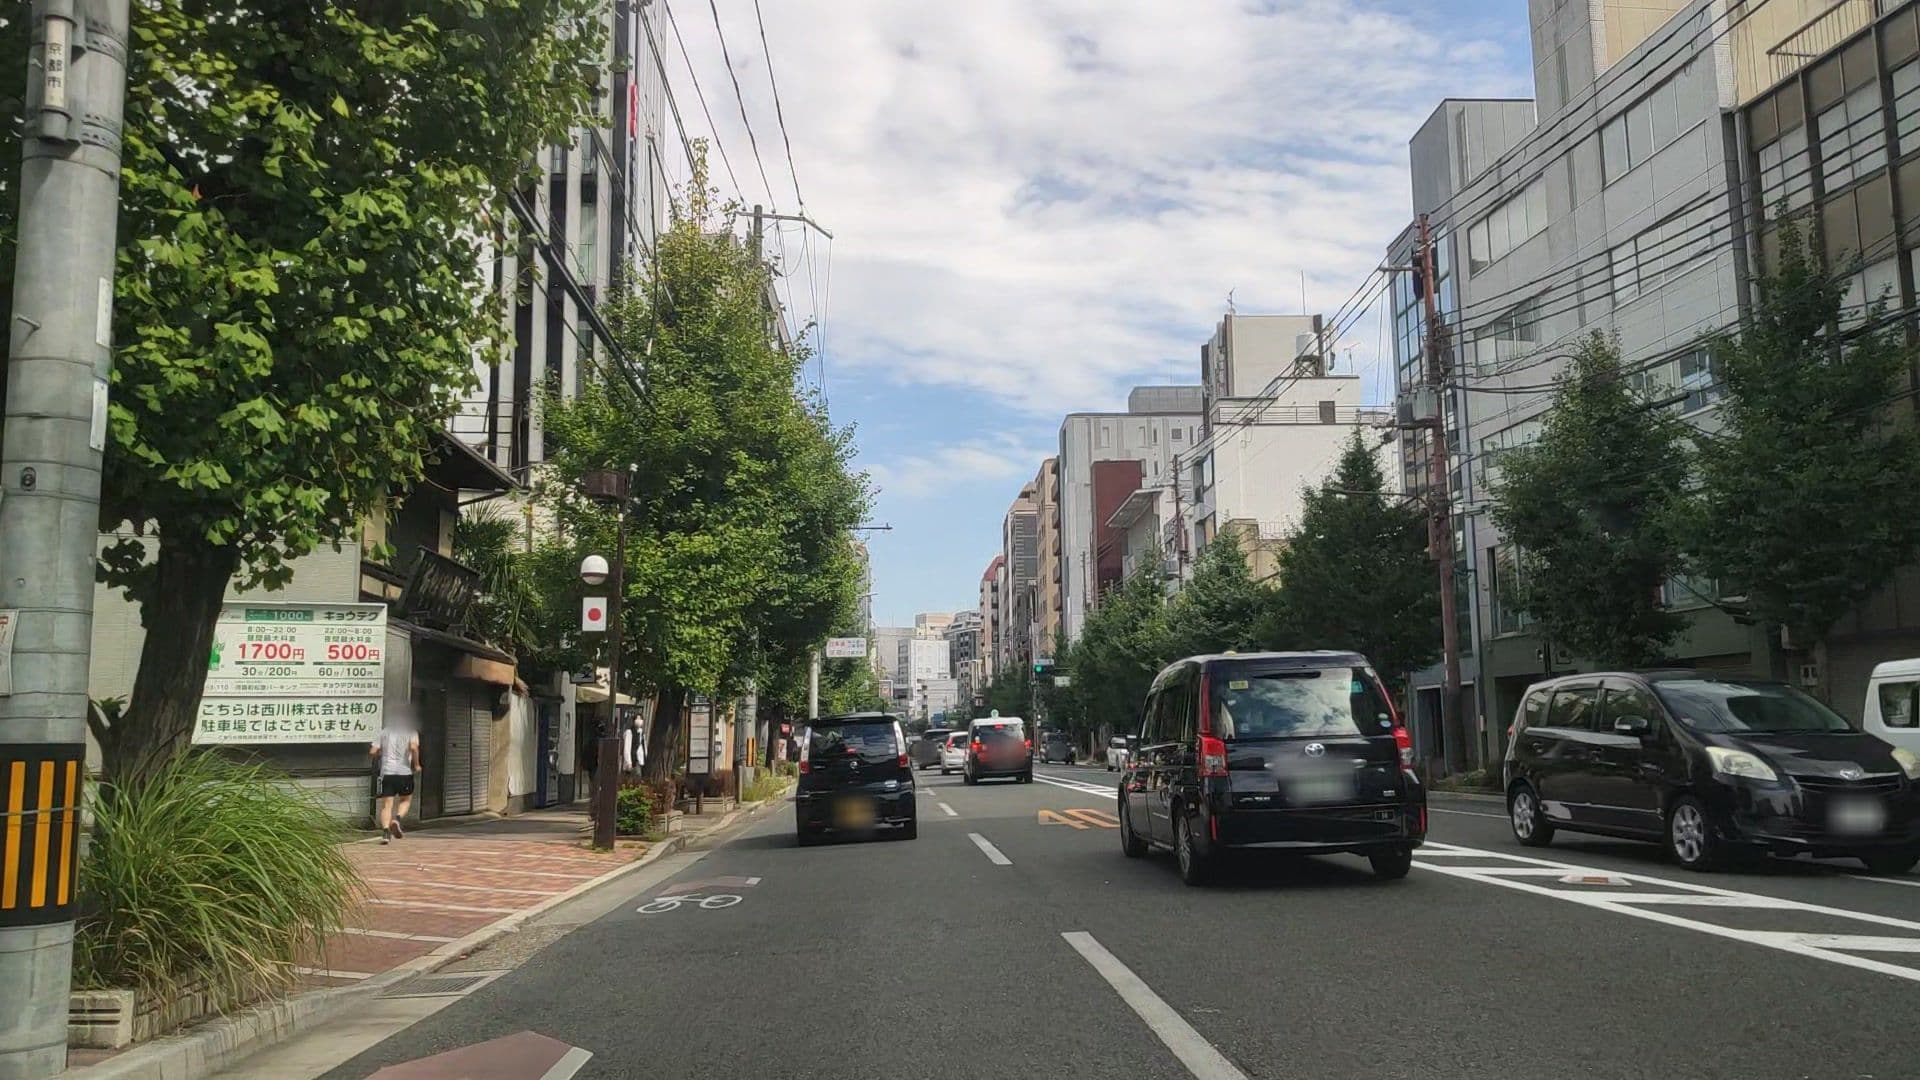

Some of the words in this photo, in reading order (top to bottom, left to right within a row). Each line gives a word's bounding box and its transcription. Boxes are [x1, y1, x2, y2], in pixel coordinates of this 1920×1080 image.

[47, 43, 63, 88] 京都市
[324, 610, 379, 621] キョウテク
[238, 643, 305, 660] 1700円
[327, 644, 380, 660] 500円
[202, 703, 378, 717] こちらは西川株式会社様の
[201, 719, 374, 733] 駐車場ではございません。
[1038, 808, 1121, 829] 40
